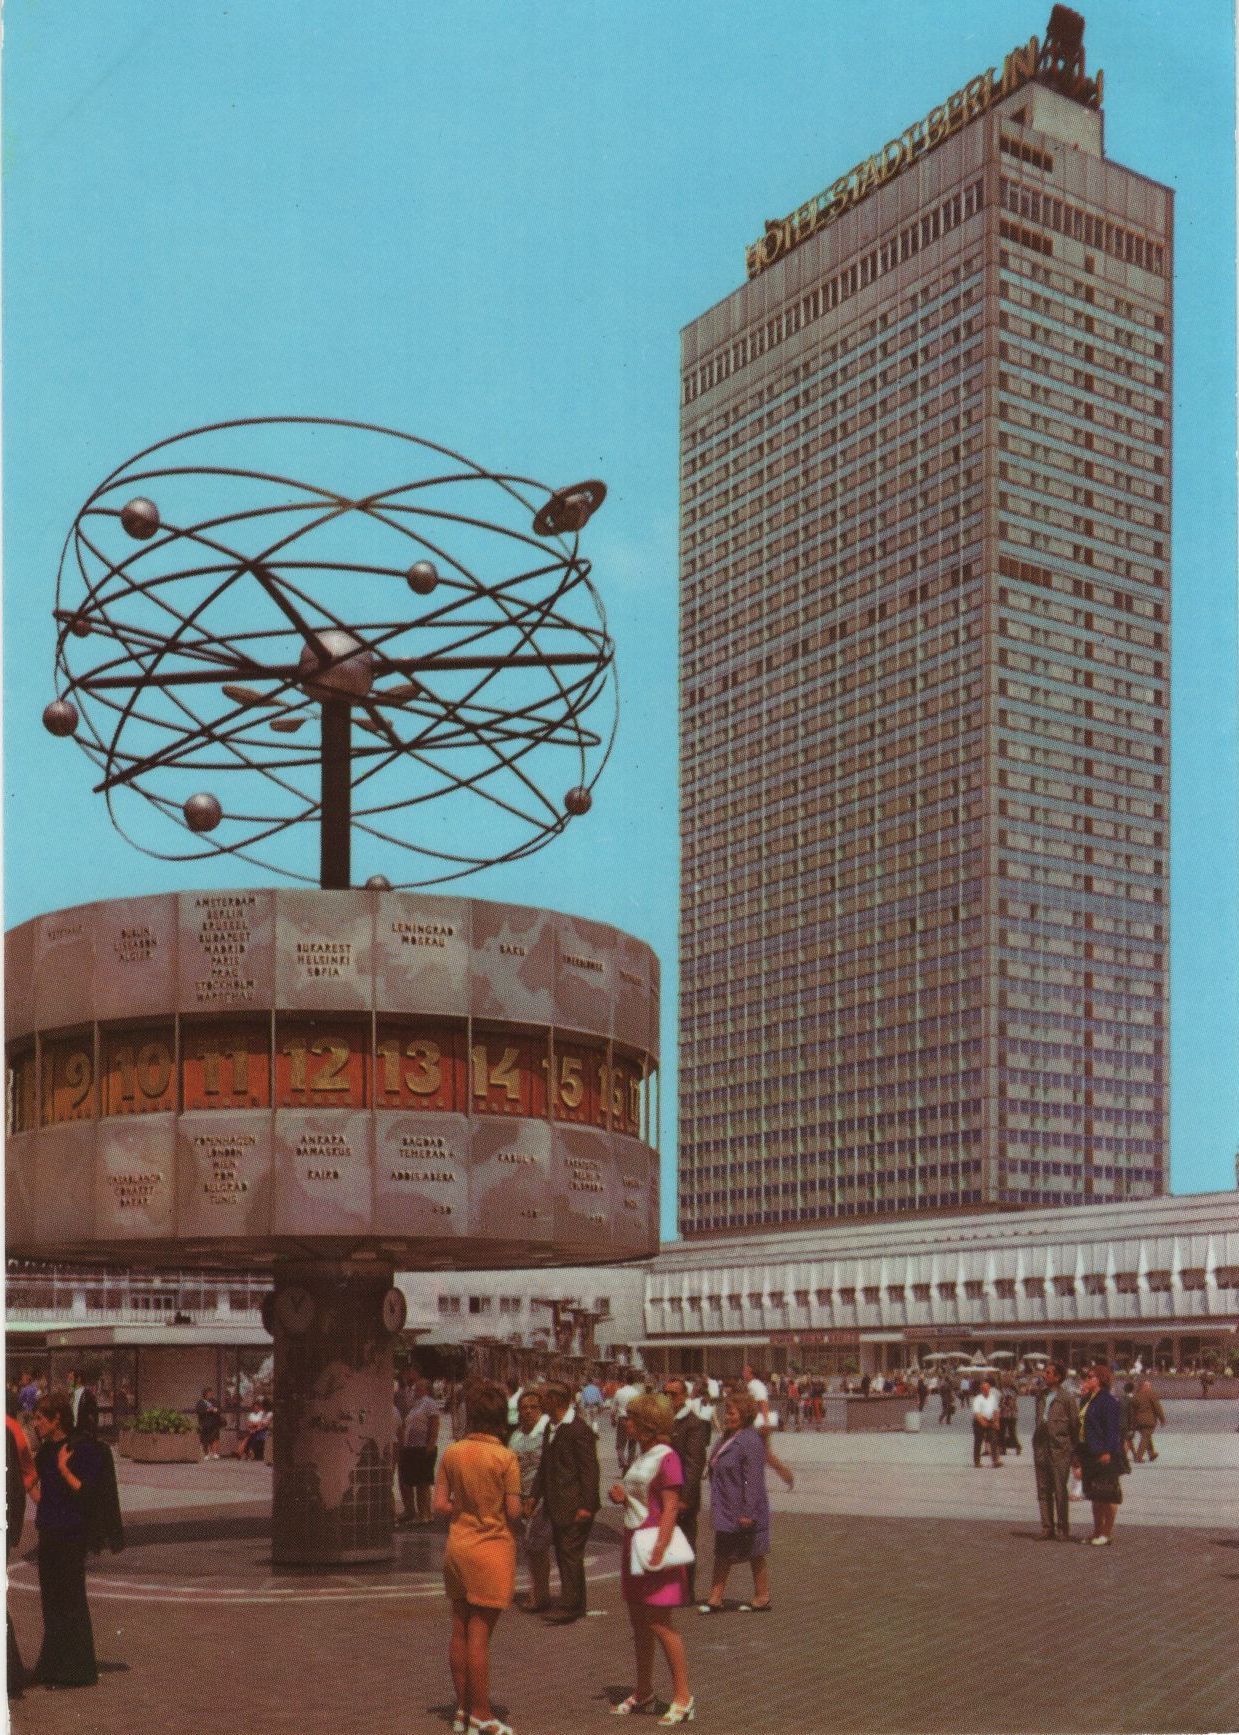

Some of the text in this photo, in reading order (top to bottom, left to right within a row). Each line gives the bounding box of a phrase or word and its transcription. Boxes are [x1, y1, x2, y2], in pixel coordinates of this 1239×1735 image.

[745, 195, 828, 279] HOTEL
[829, 121, 922, 216] STADT
[922, 35, 1039, 153] BERLIN
[195, 897, 255, 908] AMSTERDAM
[391, 923, 453, 936] LENINGRAD
[199, 932, 250, 943] BUDAPEST
[401, 935, 445, 948] MOSKAU
[204, 944, 245, 954] MADRID
[296, 943, 351, 953] BUKAREST
[297, 955, 351, 966] HELSINKI
[308, 967, 340, 977] SOFIA
[115, 1044, 170, 1099] 10
[199, 1046, 248, 1095] 11
[283, 1038, 350, 1092] 12
[377, 1039, 442, 1096] 13
[472, 1045, 520, 1100] 14
[65, 1053, 93, 1109] 9
[542, 1056, 583, 1108] 15
[300, 1135, 346, 1145] ANKARA
[296, 1148, 351, 1158] DAMASKUS
[307, 1170, 340, 1181] KAIRO
